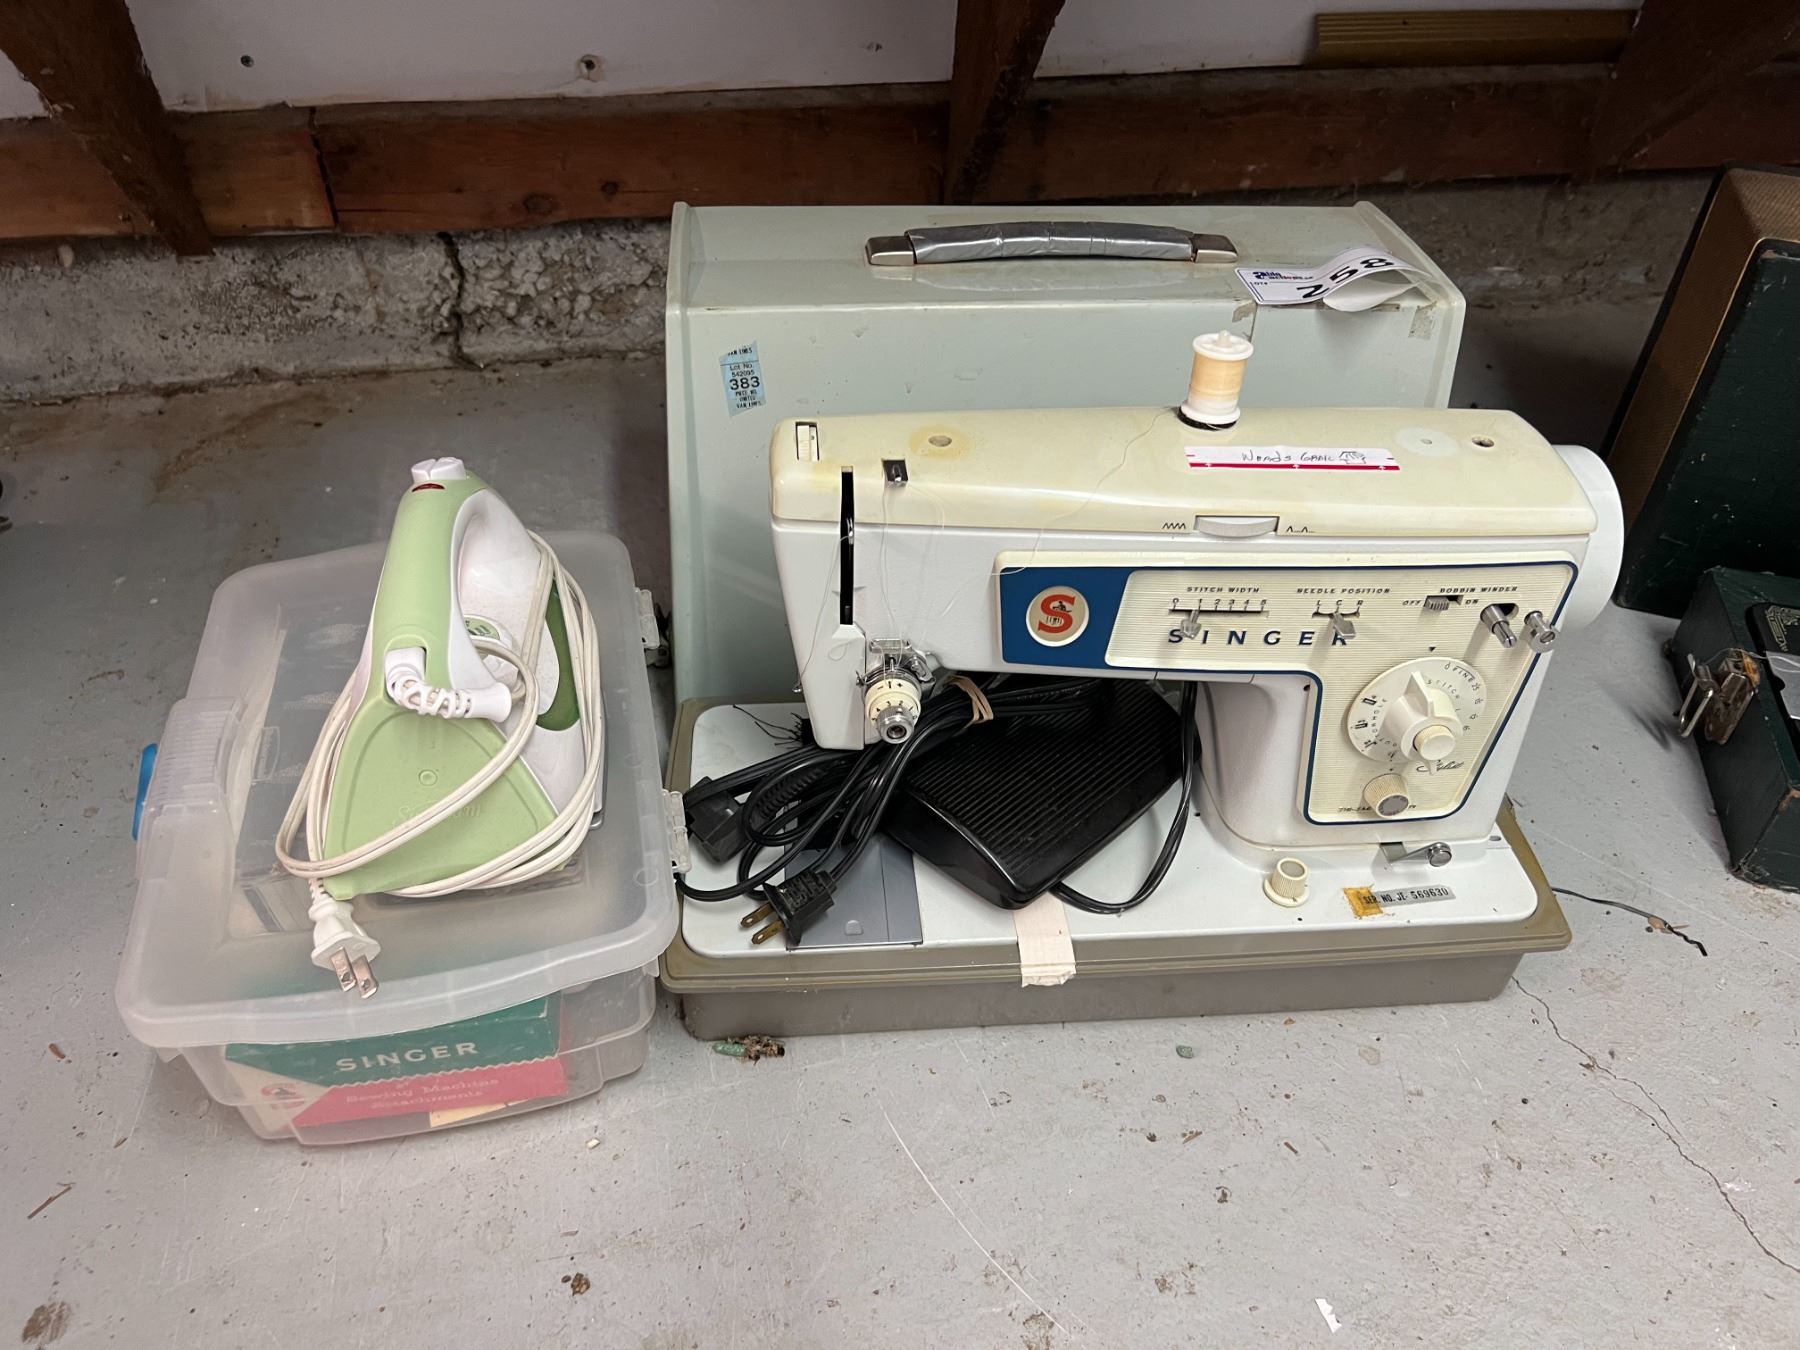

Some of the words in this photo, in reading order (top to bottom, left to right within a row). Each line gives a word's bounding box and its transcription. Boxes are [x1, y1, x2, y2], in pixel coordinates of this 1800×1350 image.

[1296, 257, 1394, 300] 258
[729, 376, 760, 391] 383
[1409, 887, 1449, 900] 569630
[336, 1042, 478, 1072] SINGER
